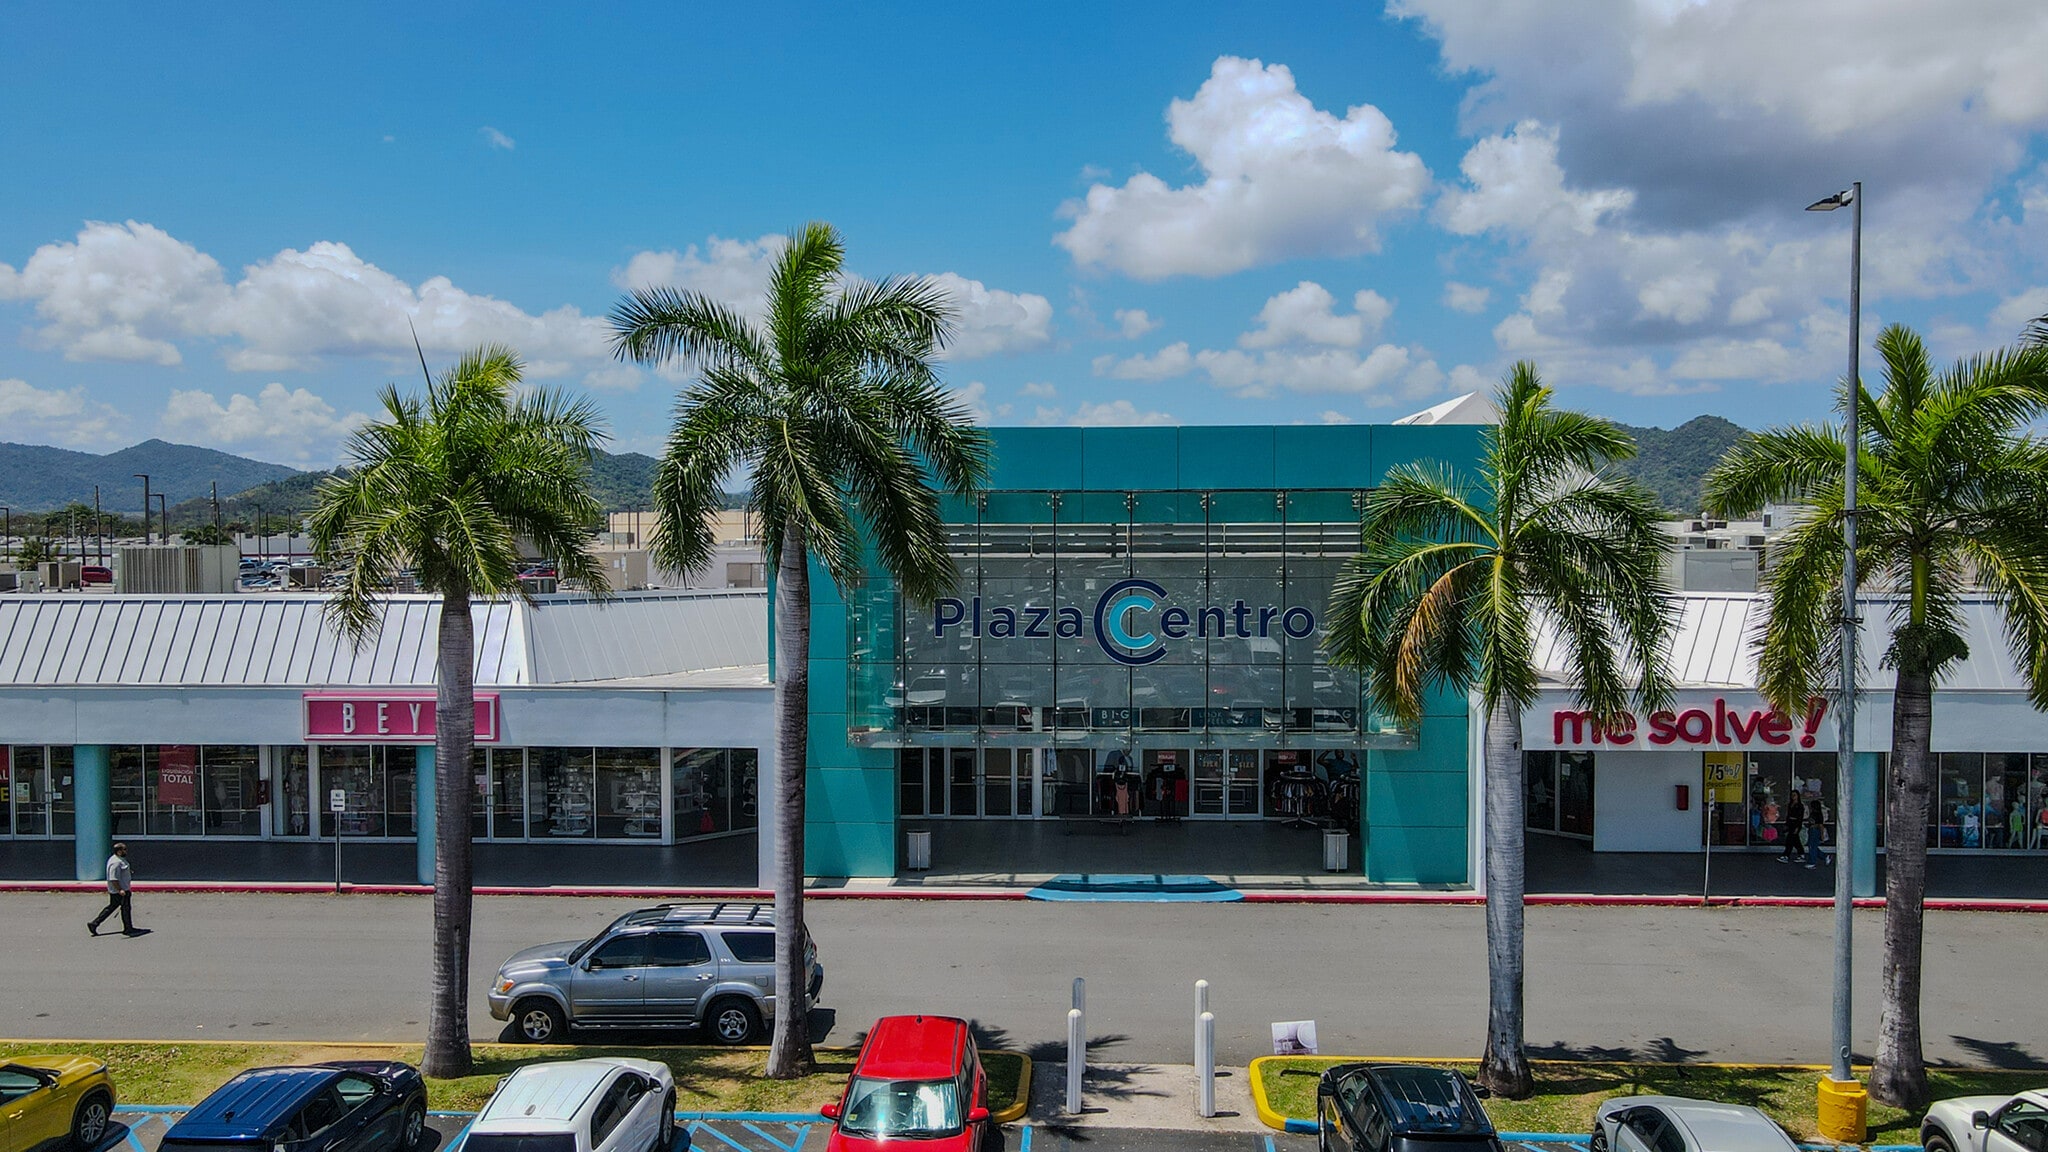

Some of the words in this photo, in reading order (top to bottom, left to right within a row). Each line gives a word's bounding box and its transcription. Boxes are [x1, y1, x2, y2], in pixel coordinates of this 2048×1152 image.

[933, 596, 1084, 639] Plaza
[342, 702, 423, 733] BEY
[1101, 709, 1129, 719] BIG
[1553, 710, 1637, 744] me
[162, 773, 193, 784] TOTAL
